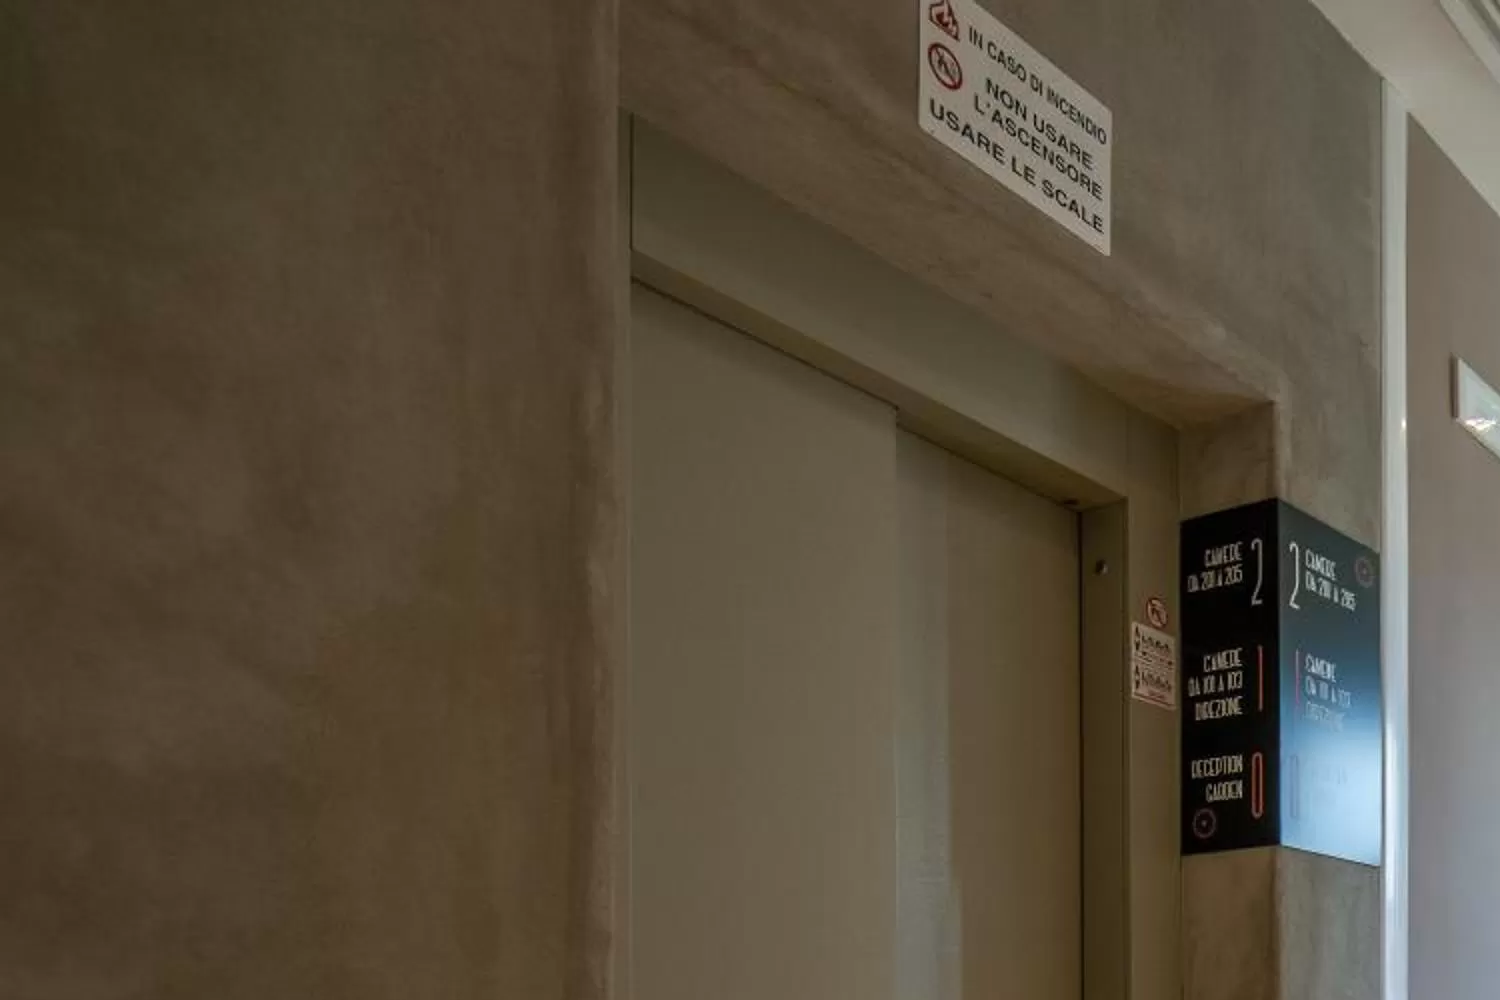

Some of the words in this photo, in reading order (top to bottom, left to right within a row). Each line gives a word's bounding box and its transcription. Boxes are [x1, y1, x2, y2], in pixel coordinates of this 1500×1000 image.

[968, 26, 983, 51] IN
[987, 41, 1026, 80] CASO
[1030, 73, 1043, 97] DI
[1047, 86, 1107, 145] INCENDIO
[986, 77, 1027, 121] NON
[1033, 113, 1093, 171] USARE
[930, 97, 1006, 165] USARE
[1011, 154, 1036, 187] LE
[1042, 179, 1104, 234] SCALE
[974, 92, 1103, 201] L'ASCENSORE
[1251, 538, 1263, 606] 2
[1289, 541, 1300, 609] 2
